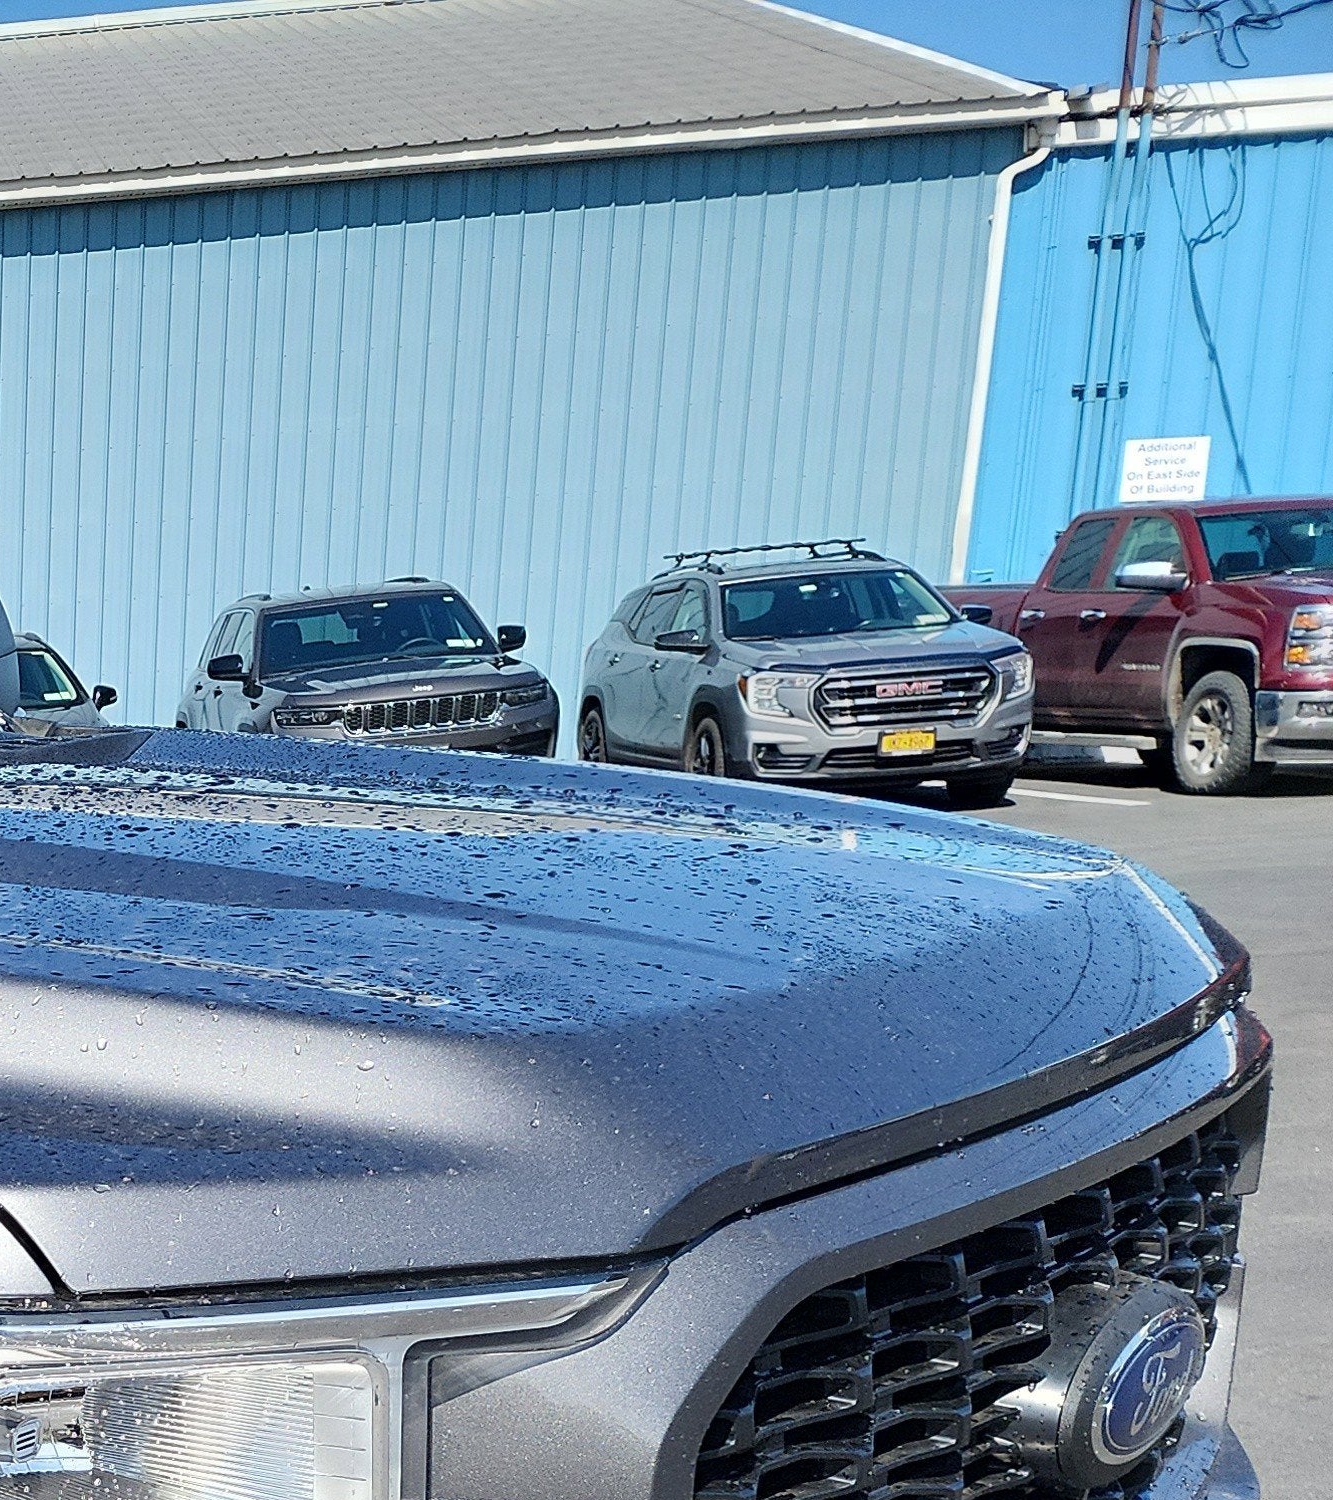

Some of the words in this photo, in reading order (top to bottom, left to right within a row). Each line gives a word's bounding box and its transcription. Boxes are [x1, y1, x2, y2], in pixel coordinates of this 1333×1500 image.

[1137, 441, 1197, 453] Additional
[1144, 457, 1186, 467] Service
[1127, 471, 1143, 481] On
[1147, 471, 1172, 480] East
[1176, 469, 1200, 479] Side
[1130, 485, 1143, 494] Of
[1147, 484, 1194, 494] Building
[876, 680, 943, 698] GMC
[1130, 1341, 1183, 1436] Ford
